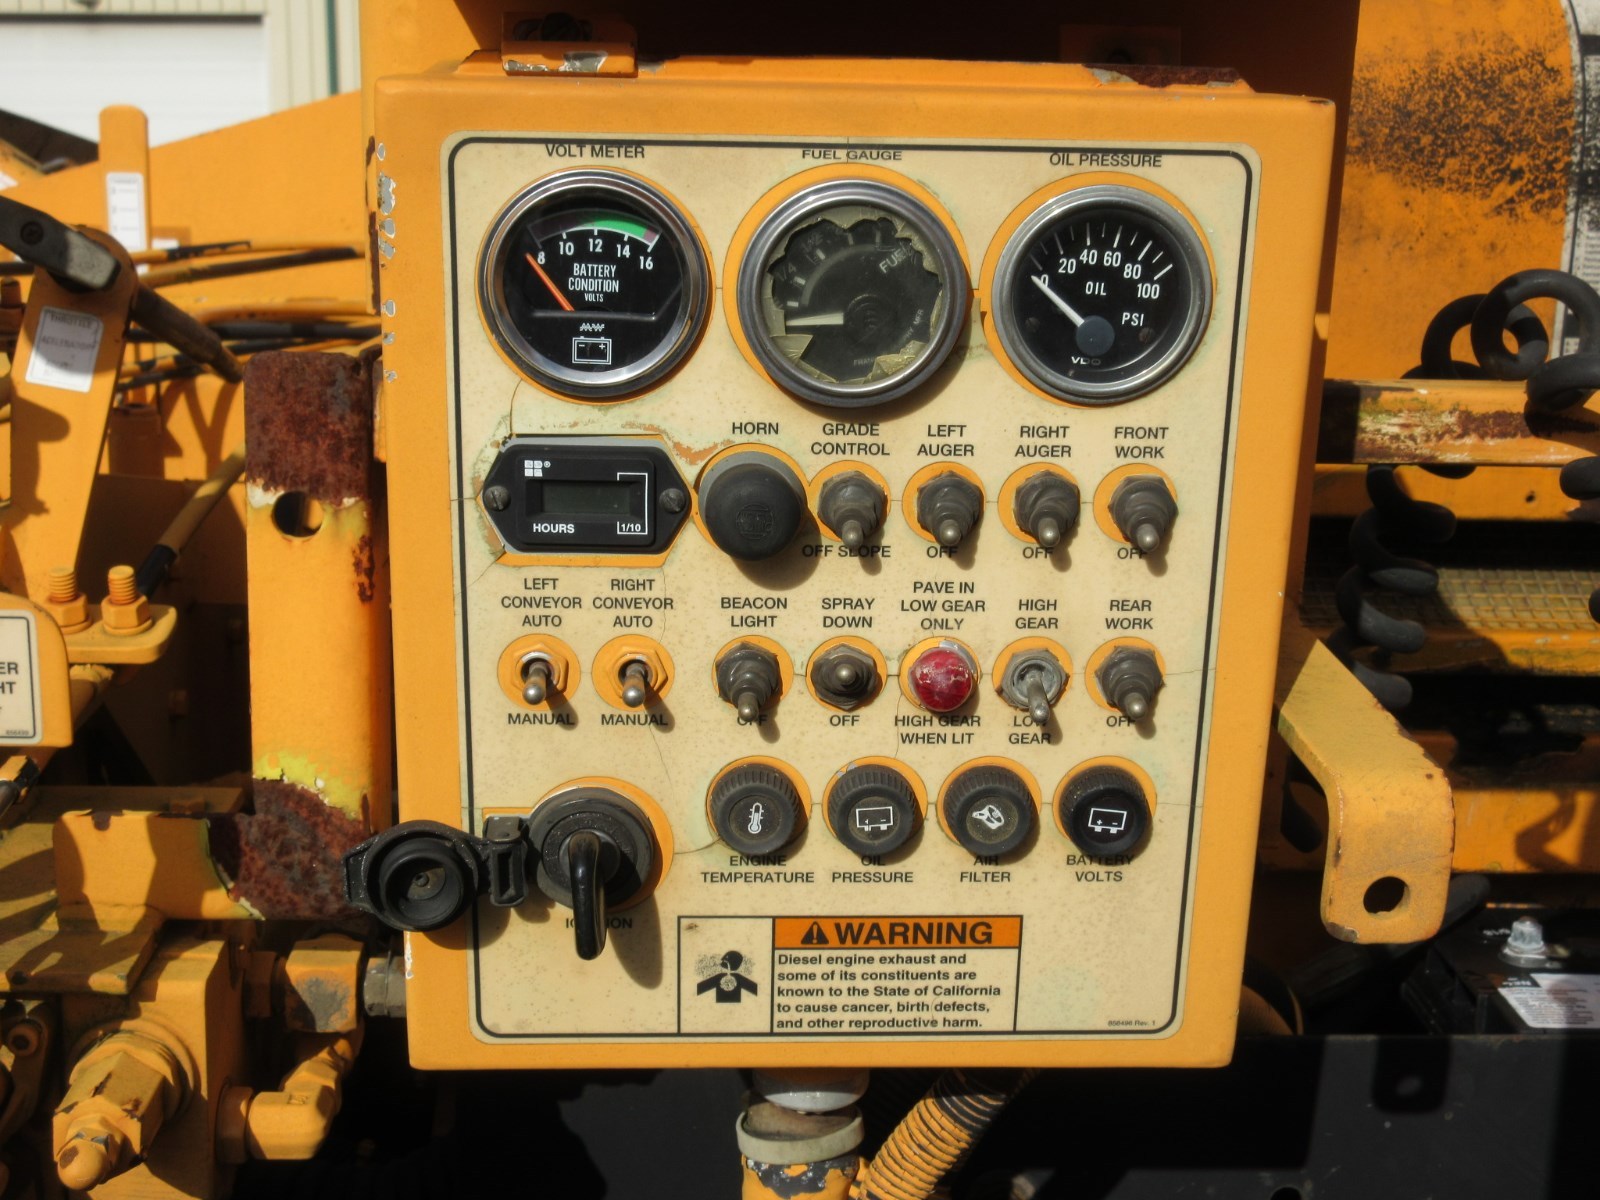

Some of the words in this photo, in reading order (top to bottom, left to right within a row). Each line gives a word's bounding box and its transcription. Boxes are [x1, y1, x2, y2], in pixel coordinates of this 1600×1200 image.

[545, 144, 585, 158] VOLT
[591, 145, 645, 159] METER
[802, 149, 841, 160] FUEL
[846, 150, 902, 161] GAUGE
[1050, 153, 1074, 166] OIL
[1079, 153, 1162, 167] PRESSURE
[537, 251, 546, 265] 8
[559, 242, 574, 256] 10
[588, 239, 603, 253] 12
[616, 244, 631, 259] 14
[639, 256, 654, 270] 16
[573, 263, 617, 278] BATTERY
[1041, 274, 1049, 288] 0
[1058, 258, 1077, 274] 20
[1079, 249, 1098, 265] 40
[1103, 251, 1121, 267] 60
[1123, 263, 1142, 280] 80
[1137, 283, 1160, 299] 100
[568, 277, 619, 293] CONDITION
[1085, 281, 1107, 296] OIL
[584, 293, 604, 302] VOLTS
[1122, 312, 1144, 327] PSI
[1071, 356, 1101, 366] VDO
[732, 422, 779, 435] HORN
[822, 423, 880, 436] GRADE
[927, 424, 967, 437] LEFT
[1020, 425, 1070, 438] RIGHT
[1114, 427, 1169, 440] FRONT
[810, 442, 890, 456] CONTROL
[917, 444, 975, 457] AUGER
[1014, 445, 1072, 458] AUGER
[1115, 445, 1165, 459] WORK
[533, 523, 575, 534] HOURS
[621, 523, 641, 532] 1/10
[802, 544, 833, 557] OFF
[838, 545, 891, 558] SLOPE
[926, 545, 958, 558] OFF
[1022, 546, 1054, 559] OFF
[524, 578, 559, 590] LEFT
[610, 579, 655, 591] RIGHT
[913, 581, 955, 594] PAVE
[959, 582, 975, 593] IN
[501, 596, 582, 609] CONVEYOR
[592, 597, 674, 610] CONVEYOR
[720, 597, 788, 610] BEACON
[821, 597, 875, 610] SPRAY
[901, 600, 938, 612] LOW
[941, 600, 986, 613] GEAR
[1018, 599, 1057, 612] HIGH
[1109, 599, 1152, 612] REAR
[522, 615, 562, 627] AUTO
[613, 615, 653, 628] AUTO
[730, 615, 777, 628] LIGHT
[823, 616, 873, 628] DOWN
[920, 618, 964, 630] ONLY
[1015, 617, 1059, 629] GEAR
[1105, 617, 1154, 630] WORK
[507, 713, 575, 725] MANUAL
[601, 713, 668, 726] MANUAL
[737, 714, 768, 726] OF
[829, 715, 860, 727] OFF
[894, 715, 933, 727] HIGH
[938, 715, 981, 727] GEAR
[900, 732, 947, 744] WHEN
[952, 733, 975, 744] LIT
[1008, 732, 1052, 745] GEAR
[729, 855, 787, 867] ENGINE
[861, 855, 886, 867] OIL
[973, 855, 999, 866] AIR
[1066, 854, 1135, 866] BATTERY
[701, 872, 815, 883] TEMPERATURE
[832, 872, 914, 883] PRESSURE
[960, 871, 1011, 883] FILTER
[1075, 871, 1123, 882] VOLTS
[565, 918, 633, 929] IION
[834, 921, 993, 945] WARNING
[778, 954, 822, 965] Diesel
[826, 954, 875, 967] engine
[879, 954, 936, 965] exhaust
[940, 953, 967, 964] and
[777, 972, 817, 981] some
[821, 970, 835, 981] of
[840, 970, 857, 981] its
[861, 970, 950, 981] constituents
[954, 971, 977, 980] are
[777, 986, 824, 997] known
[829, 987, 843, 997] to
[847, 986, 869, 997] the
[874, 986, 910, 997] State
[914, 986, 929, 996] of
[932, 985, 1001, 996] California
[777, 1003, 791, 1013] to
[795, 1004, 838, 1013] cause
[841, 1004, 893, 1014] cancer,
[897, 1002, 930, 1012] birth
[934, 1001, 990, 1013] defects,
[776, 1018, 803, 1028] and
[807, 1018, 845, 1028] other
[849, 1017, 938, 1030] reproductive
[943, 1017, 982, 1028] harm.
